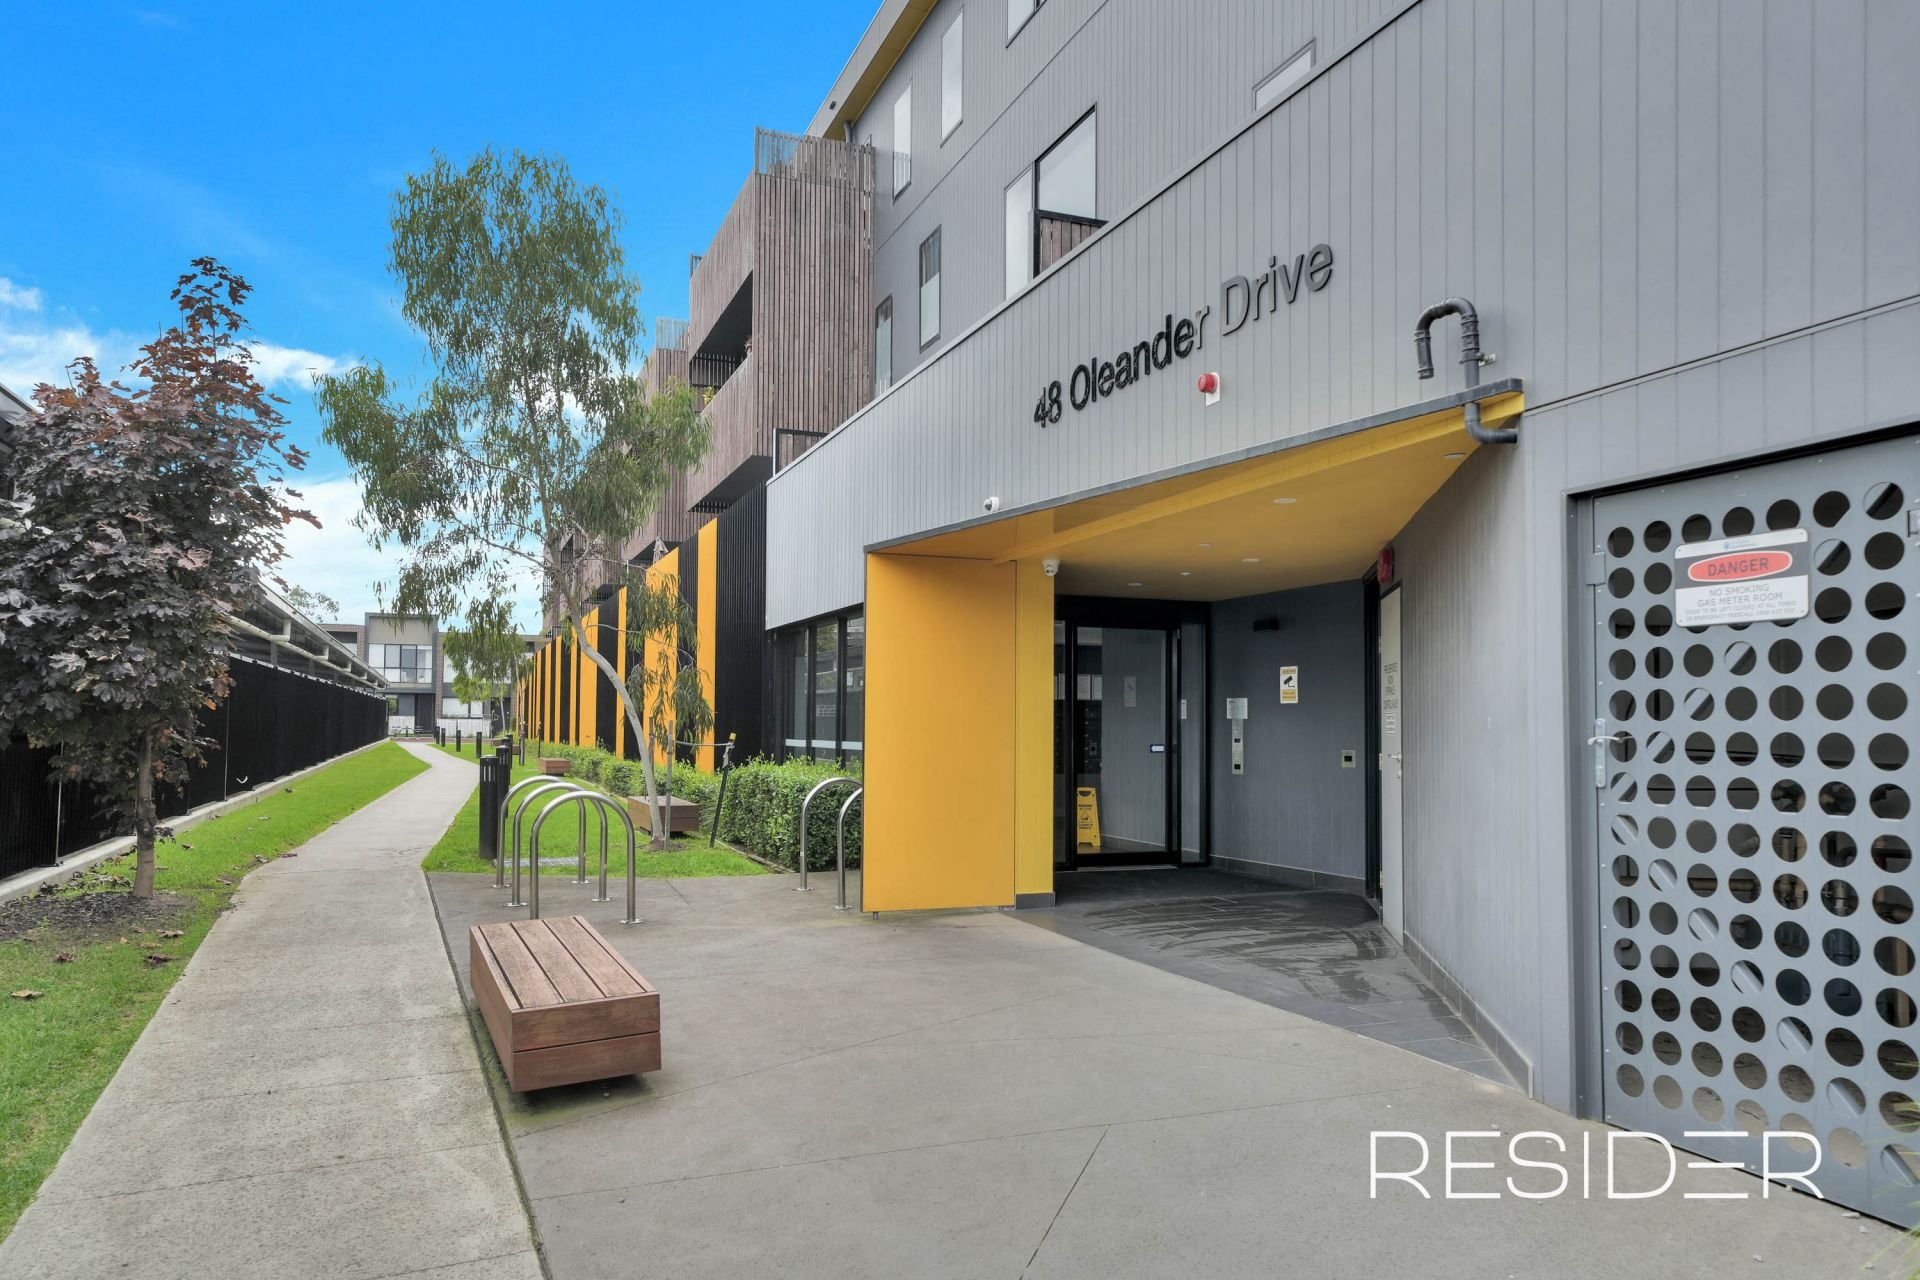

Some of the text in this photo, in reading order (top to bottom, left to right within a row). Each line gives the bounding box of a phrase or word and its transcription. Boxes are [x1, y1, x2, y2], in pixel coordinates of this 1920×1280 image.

[1034, 243, 1333, 428] 48 Oleander Drive
[1707, 557, 1770, 577] DANGER
[1697, 592, 1783, 608] GAS METER ROOM
[1709, 584, 1770, 598] NO SMOKING
